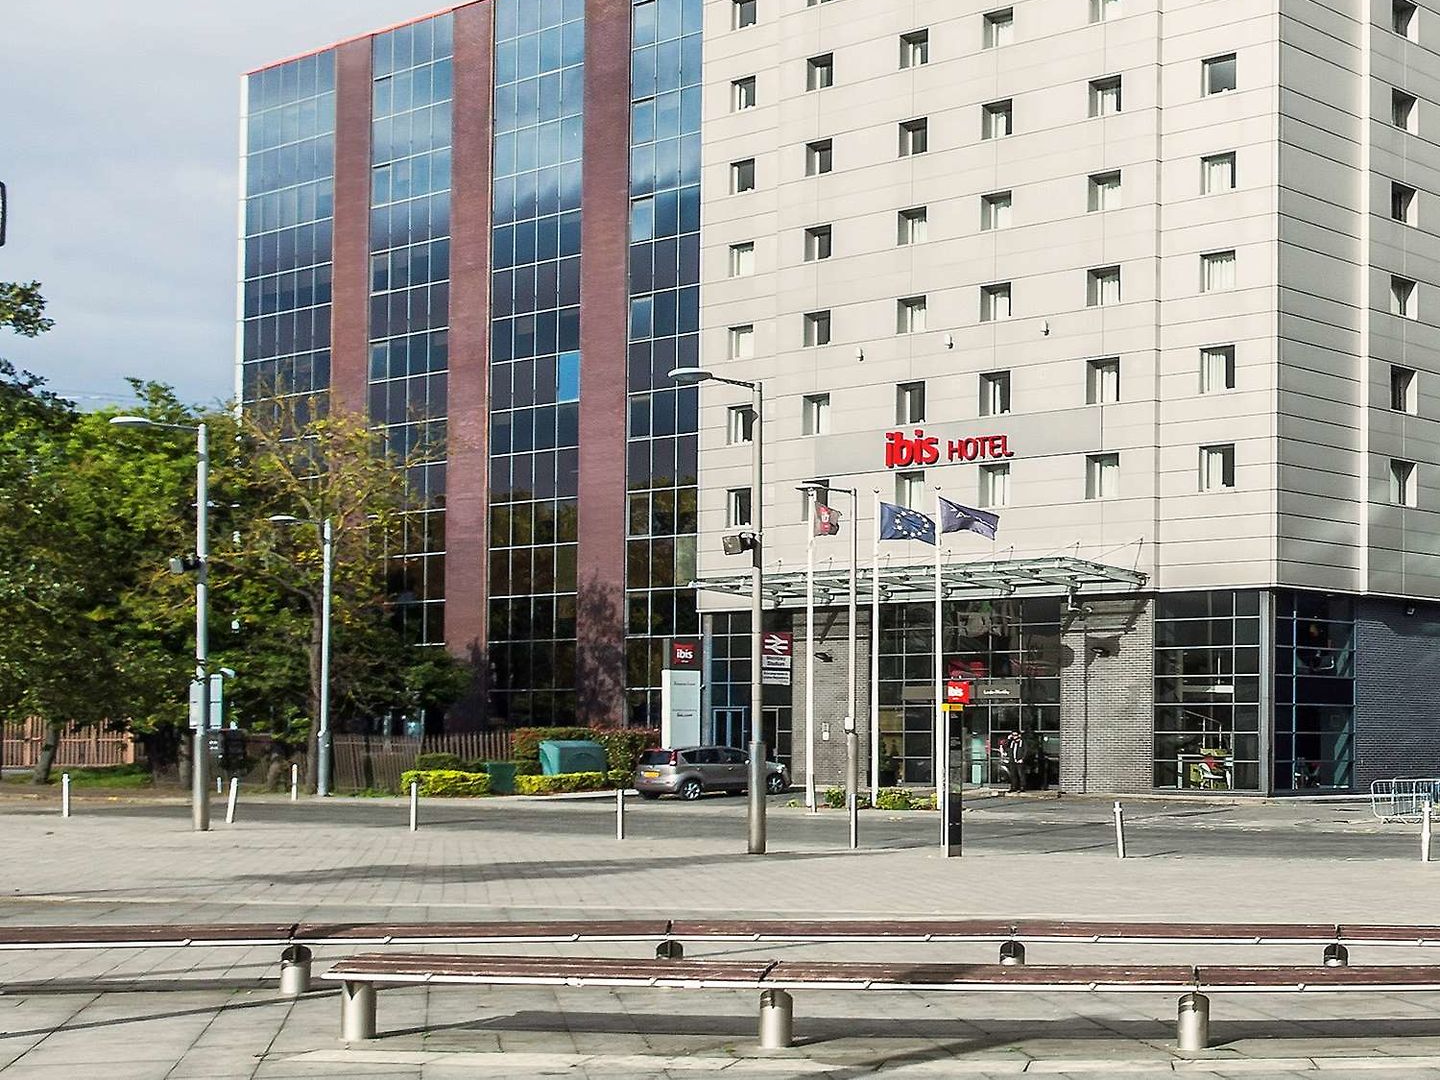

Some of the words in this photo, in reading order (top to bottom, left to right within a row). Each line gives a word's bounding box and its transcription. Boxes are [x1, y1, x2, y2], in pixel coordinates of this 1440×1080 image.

[885, 429, 940, 468] ibis
[948, 434, 1014, 462] HOTEL
[676, 648, 694, 660] ibis
